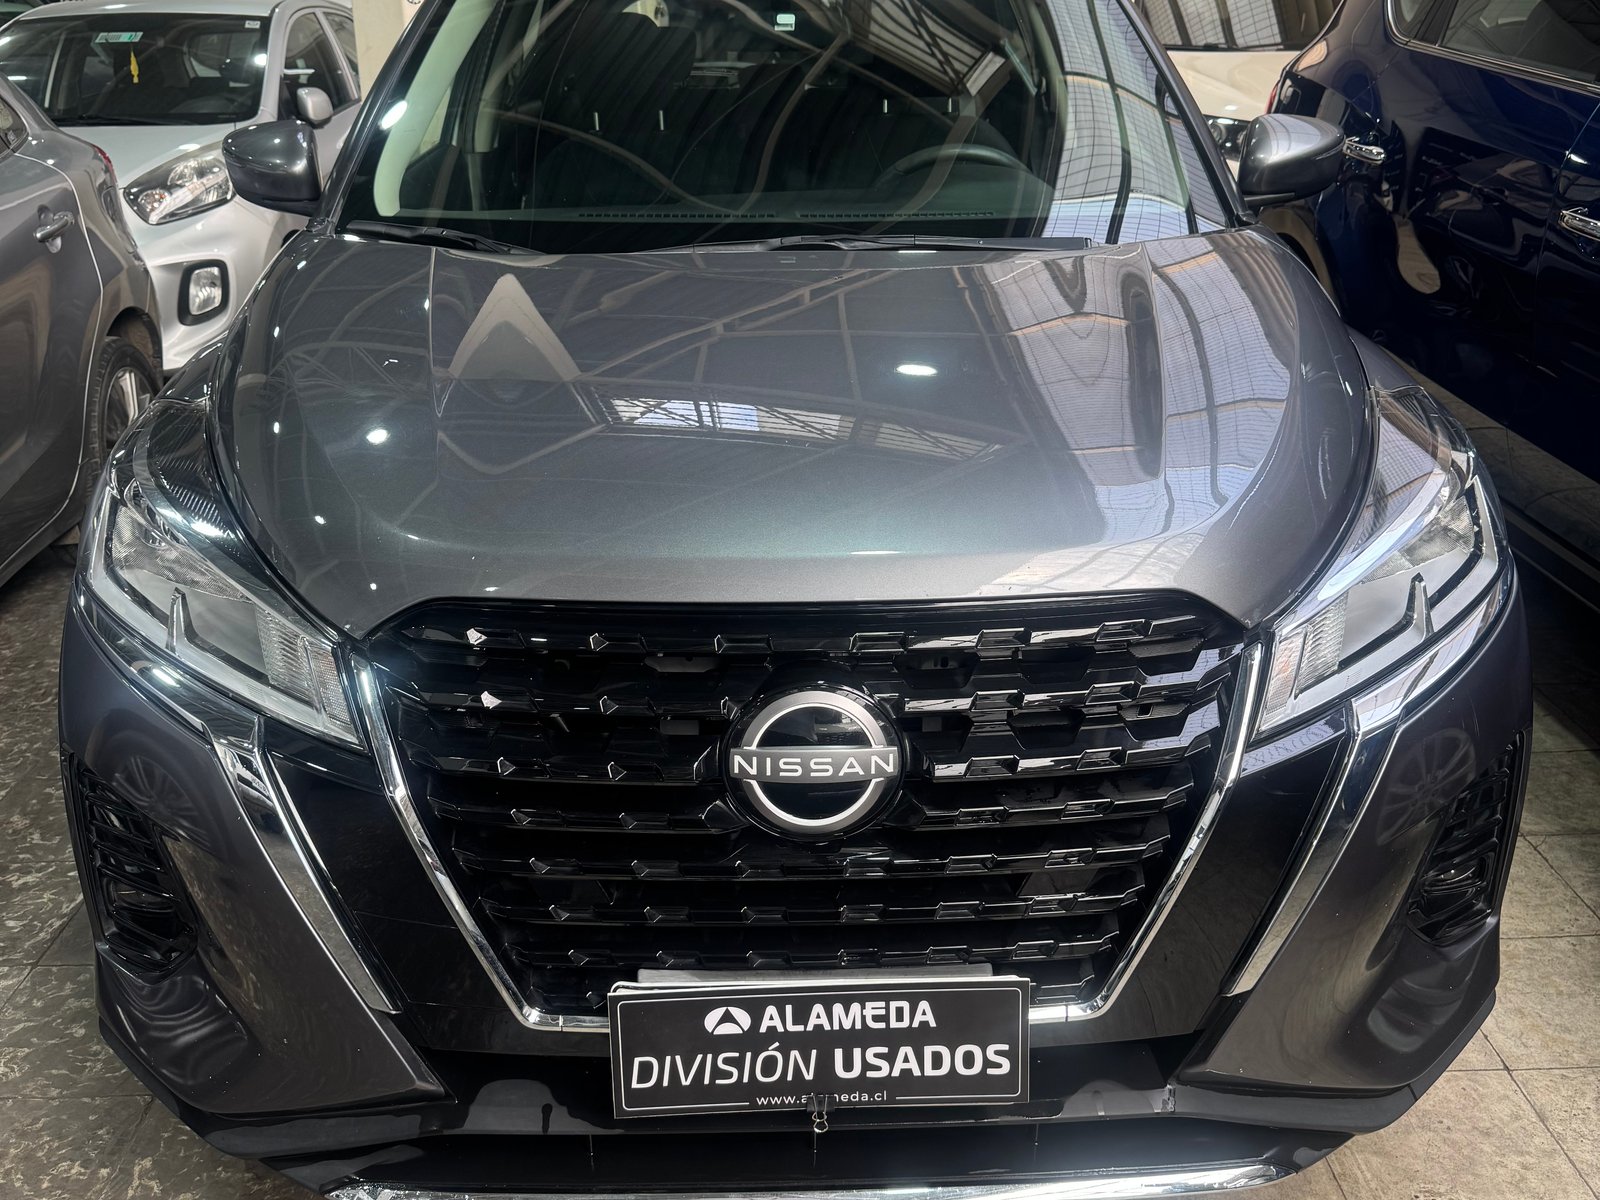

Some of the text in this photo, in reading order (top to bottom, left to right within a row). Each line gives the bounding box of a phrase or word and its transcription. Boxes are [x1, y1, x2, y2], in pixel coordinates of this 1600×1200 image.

[733, 753, 894, 777] NISSAN
[759, 1000, 937, 1033] ALAMEDA
[631, 1041, 1010, 1090] DIVISIÓN USADOS
[756, 1090, 887, 1106] www.aeda.cl
